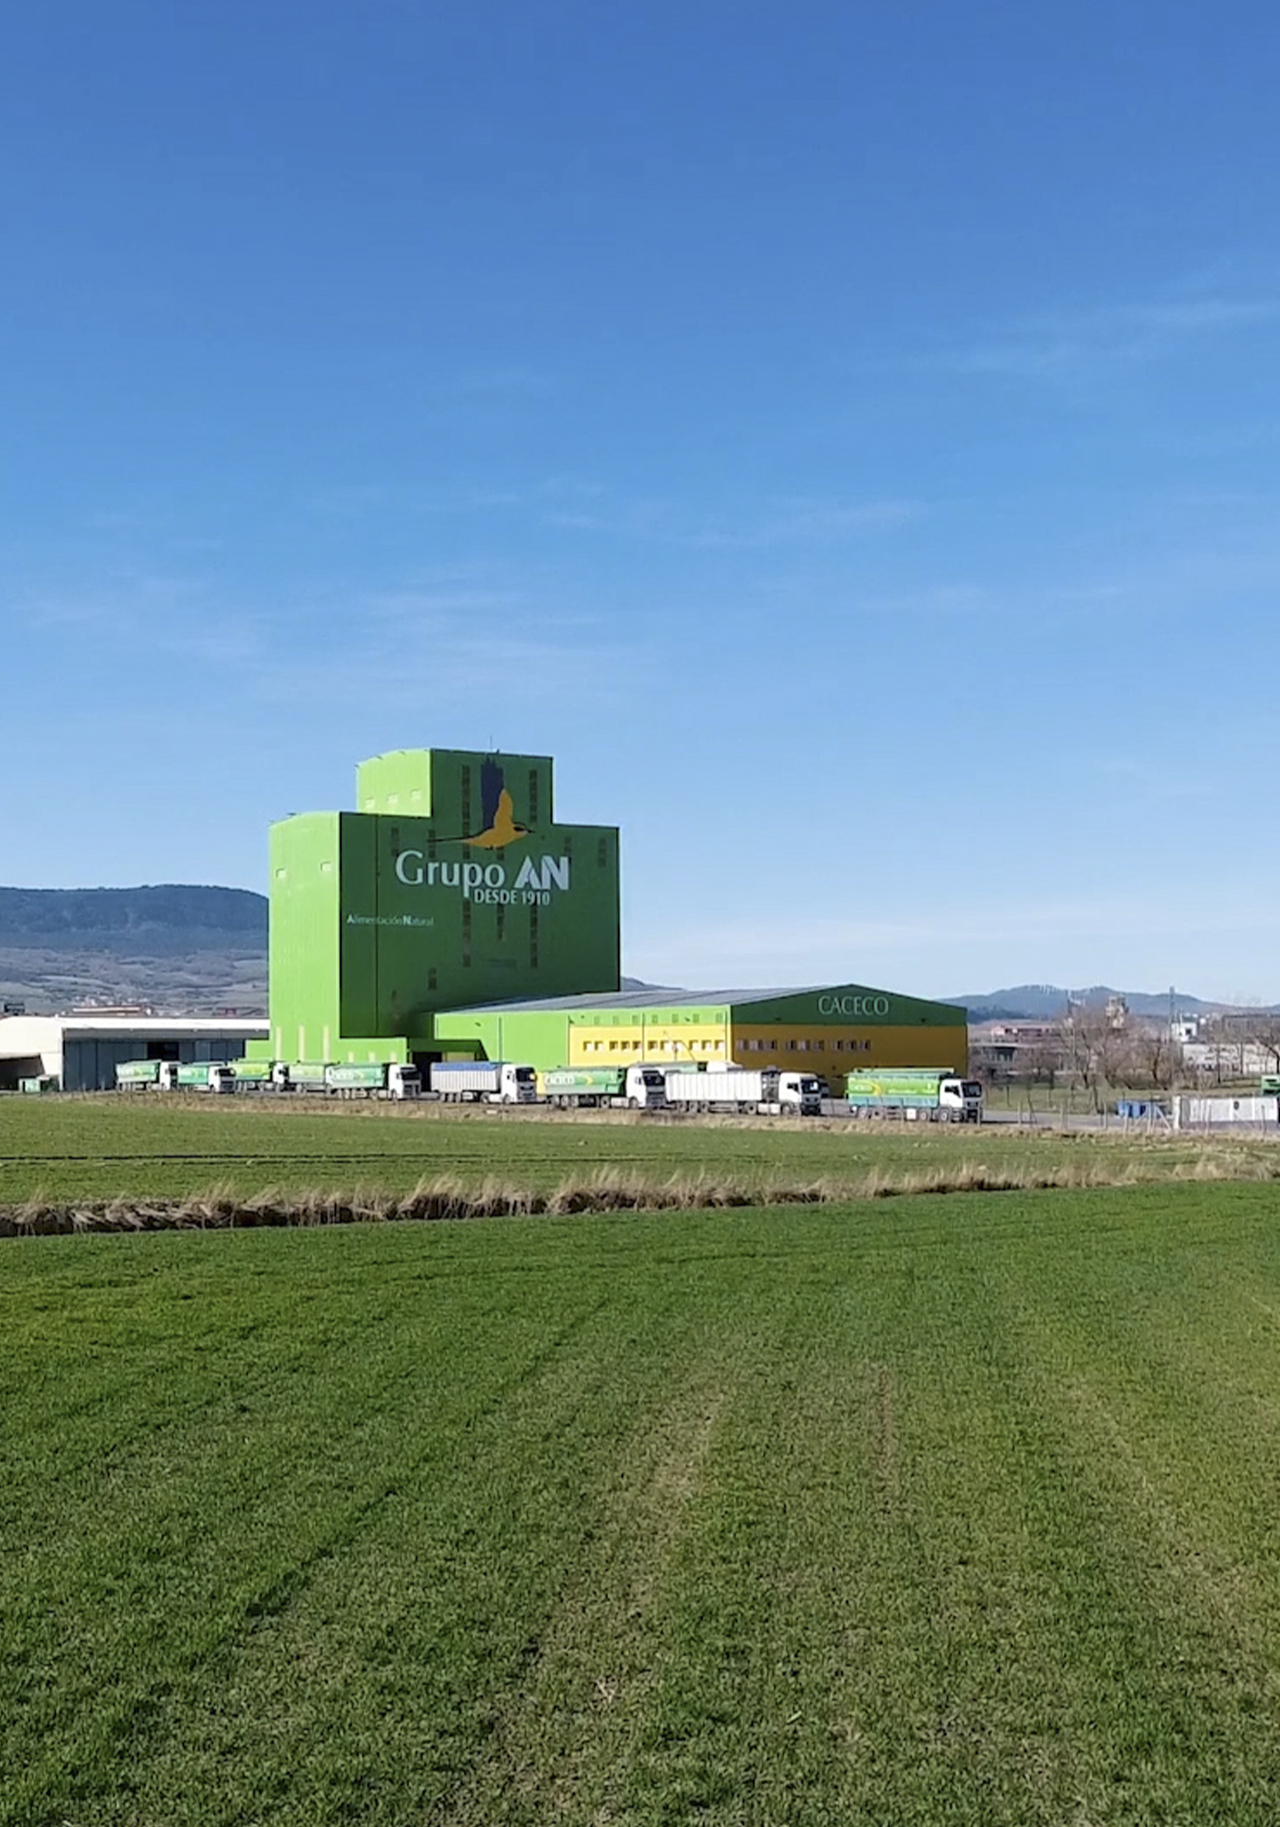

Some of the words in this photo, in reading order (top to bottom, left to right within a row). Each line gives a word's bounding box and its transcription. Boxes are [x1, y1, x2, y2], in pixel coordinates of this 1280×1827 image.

[395, 850, 505, 898] Grupo
[514, 855, 569, 891] AN
[474, 889, 517, 904] DESDE
[522, 891, 550, 906] 1910
[818, 995, 889, 1016] CACECO
